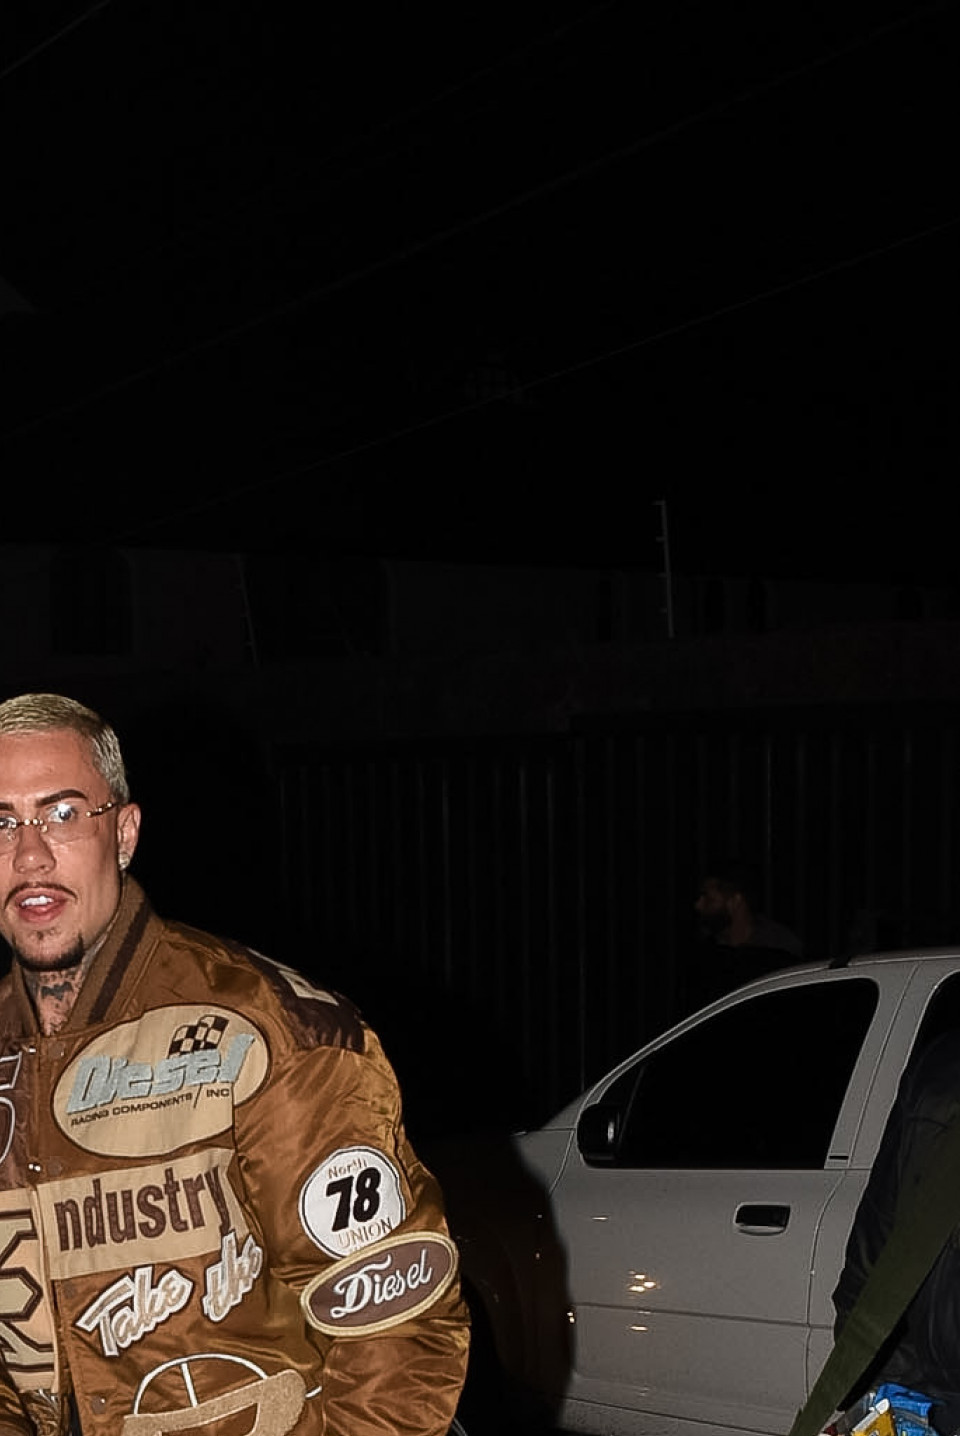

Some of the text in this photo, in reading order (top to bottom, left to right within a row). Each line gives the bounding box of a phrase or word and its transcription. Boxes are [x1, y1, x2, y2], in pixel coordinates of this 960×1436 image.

[67, 1033, 255, 1114] Diesel
[70, 1088, 230, 1126] RACING COMPONENTS INC
[326, 1167, 381, 1232] 78
[328, 1157, 368, 1180] North
[339, 1217, 393, 1248] UNION
[75, 1266, 194, 1357] Take
[329, 1248, 433, 1319] Diesel
